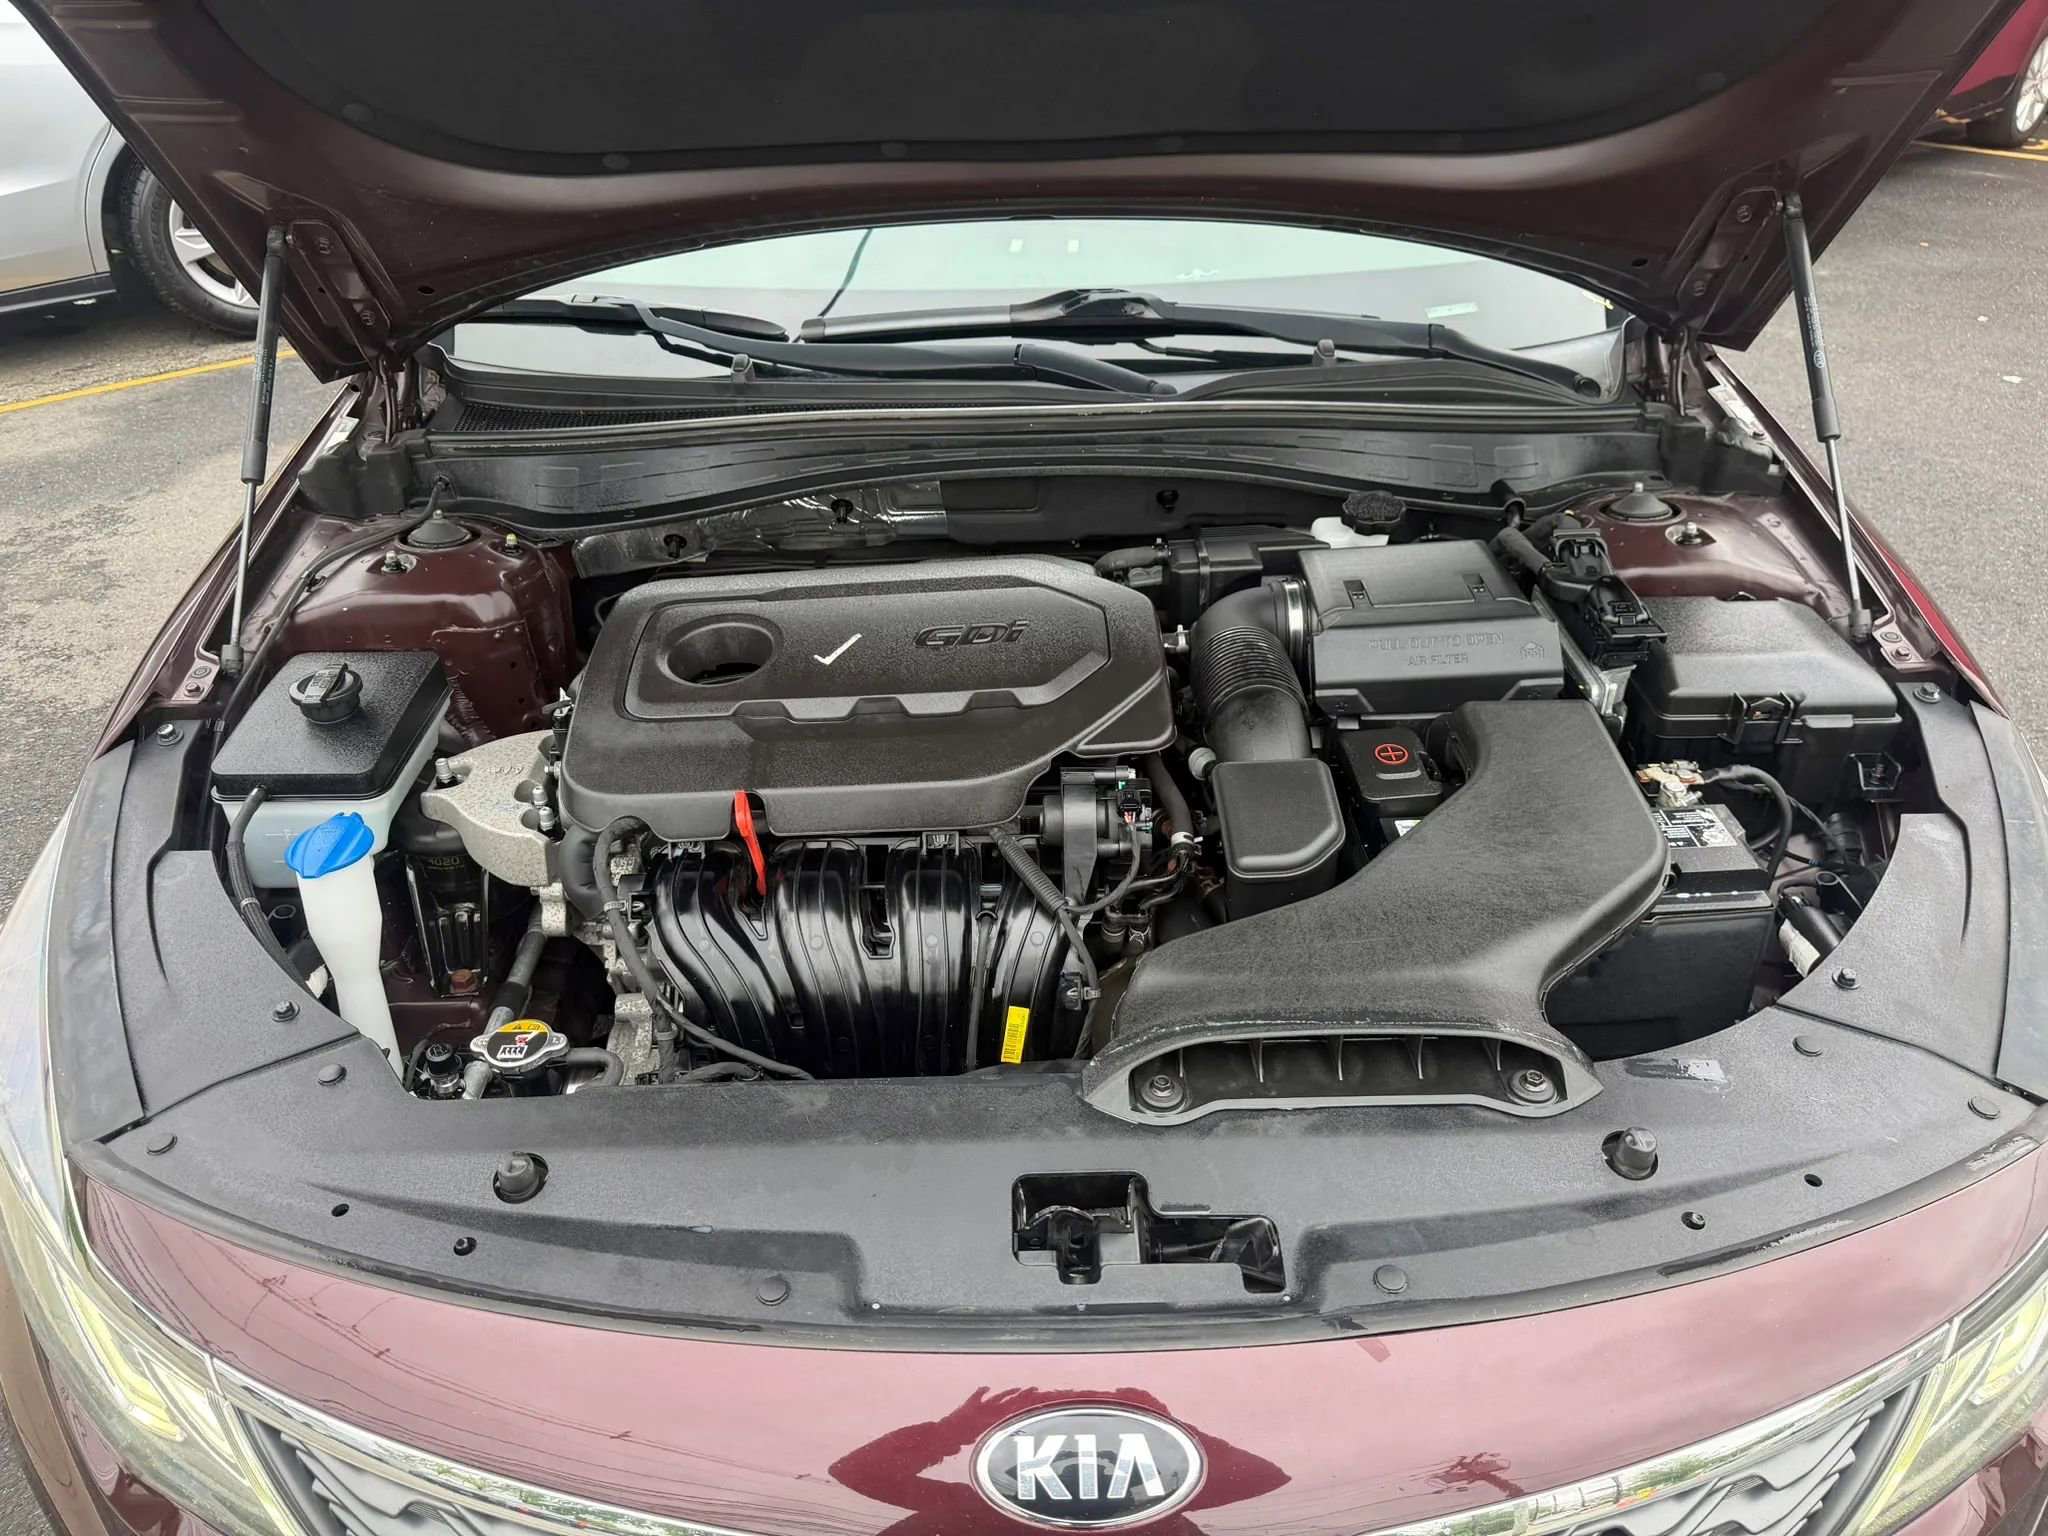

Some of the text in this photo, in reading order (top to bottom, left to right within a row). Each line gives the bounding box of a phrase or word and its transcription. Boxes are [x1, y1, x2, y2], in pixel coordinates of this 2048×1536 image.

[913, 620, 1029, 647] GDi
[1368, 632, 1504, 650] PULL OUT TO OPEN
[1408, 653, 1470, 666] AIR FILTER
[1013, 1433, 1166, 1500] KIA
